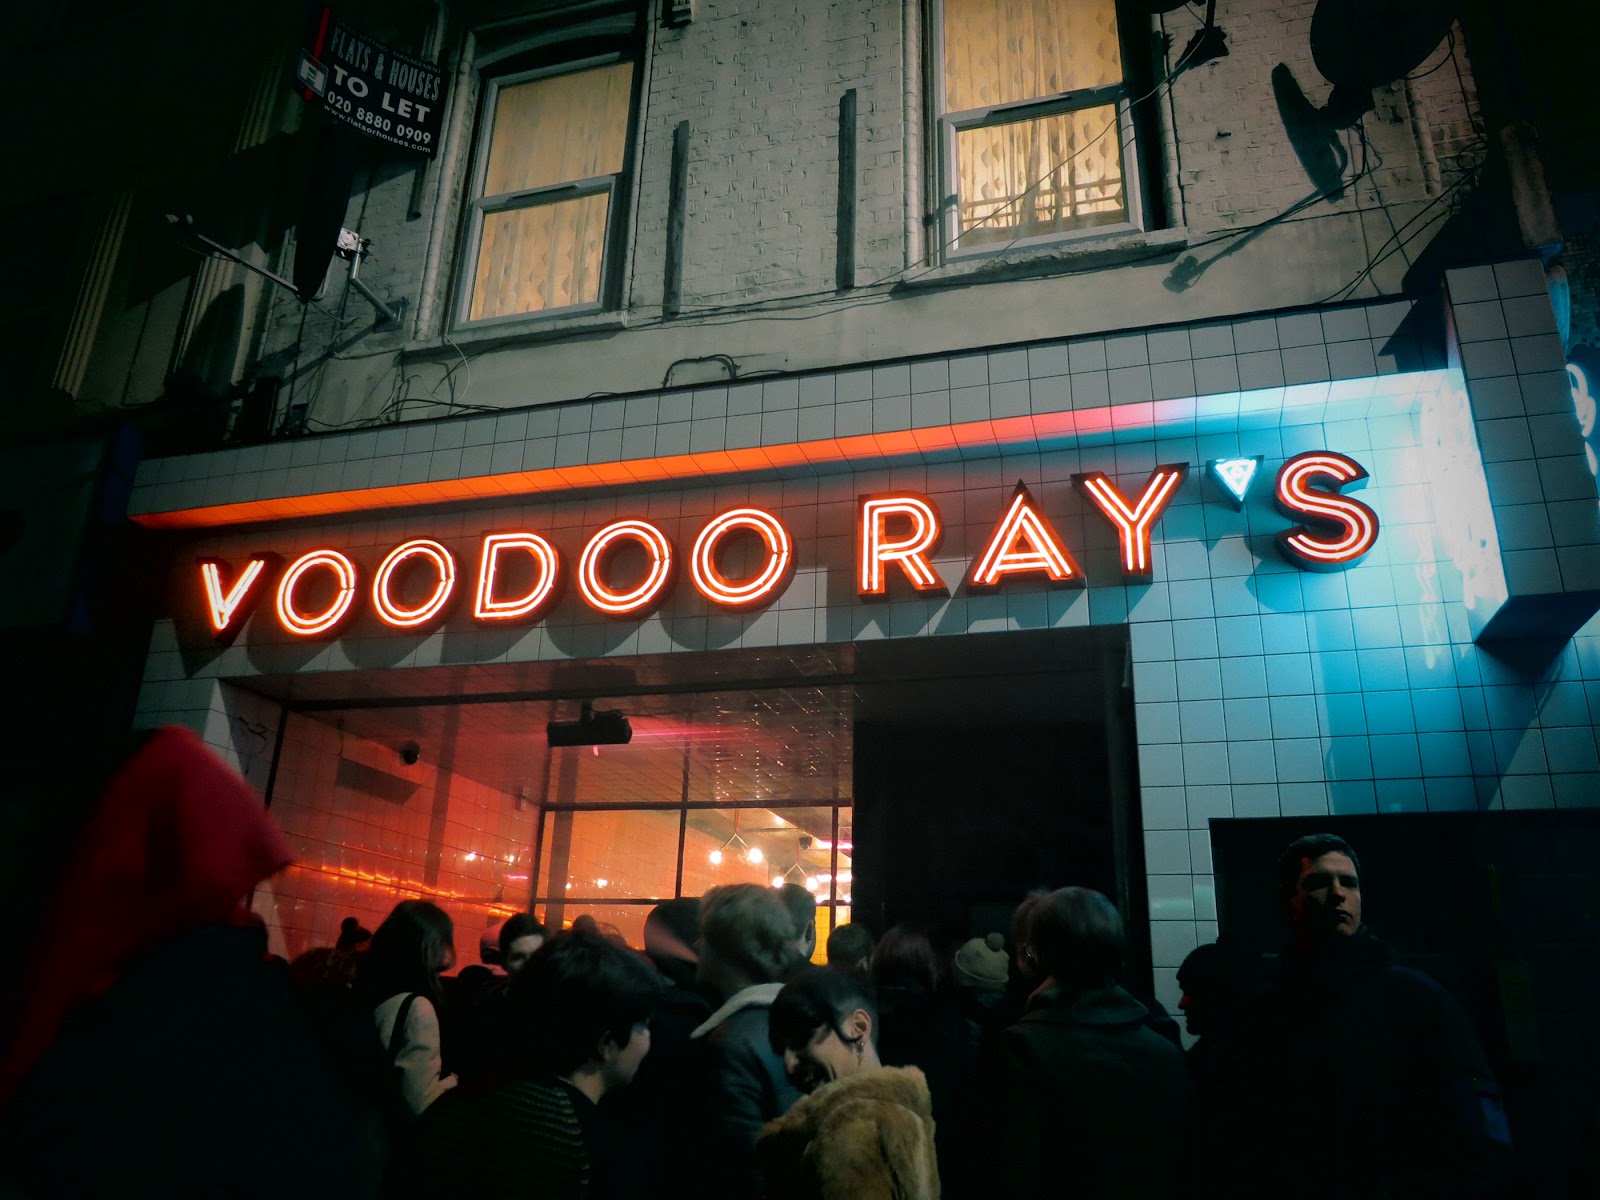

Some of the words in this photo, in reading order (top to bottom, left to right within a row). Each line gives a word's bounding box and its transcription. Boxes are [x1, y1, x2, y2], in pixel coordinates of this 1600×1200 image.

[330, 27, 372, 72] FLATS
[375, 53, 385, 80] &
[389, 60, 441, 101] HOUSES
[393, 50, 441, 74] MANAGEMENT
[327, 91, 352, 113] 020
[356, 107, 392, 131] 8880
[396, 124, 432, 144] 0909
[333, 64, 369, 98] TO
[381, 91, 431, 123] LET
[324, 104, 431, 153] www.flatsorhouses.com
[200, 504, 795, 636] VOODOO
[858, 450, 1381, 598] RAY'S
